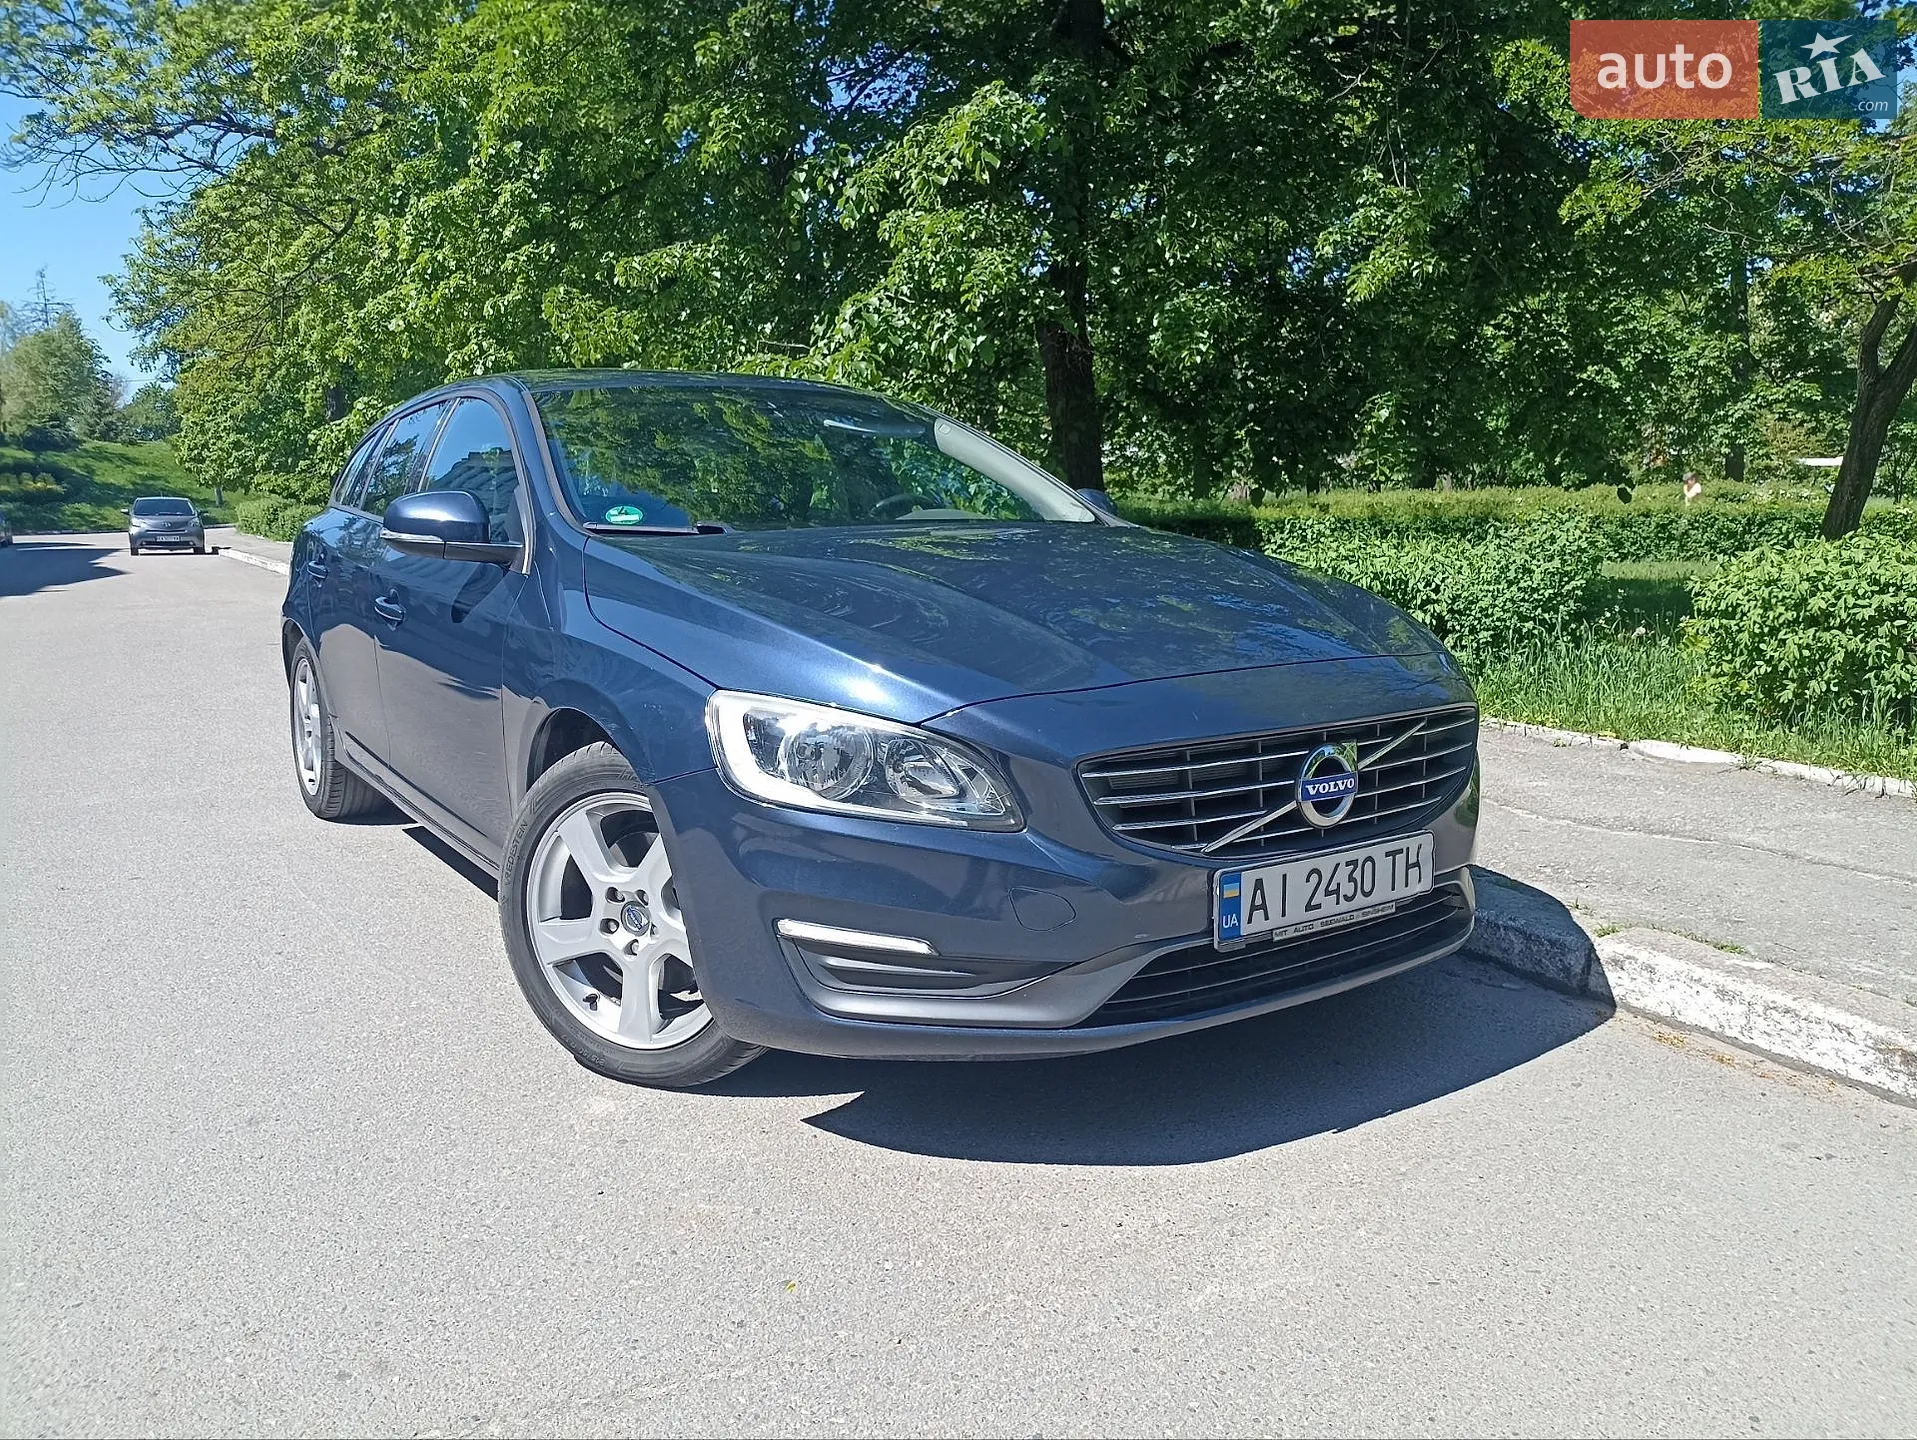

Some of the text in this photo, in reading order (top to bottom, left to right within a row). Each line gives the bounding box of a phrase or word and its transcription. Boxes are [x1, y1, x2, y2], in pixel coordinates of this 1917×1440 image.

[1305, 778, 1355, 796] VOLVO
[504, 819, 528, 886] VREDESTEIN
[1246, 843, 1424, 925] AI 2430 TH
[1222, 913, 1239, 929] UA
[1293, 923, 1314, 934] AUTO
